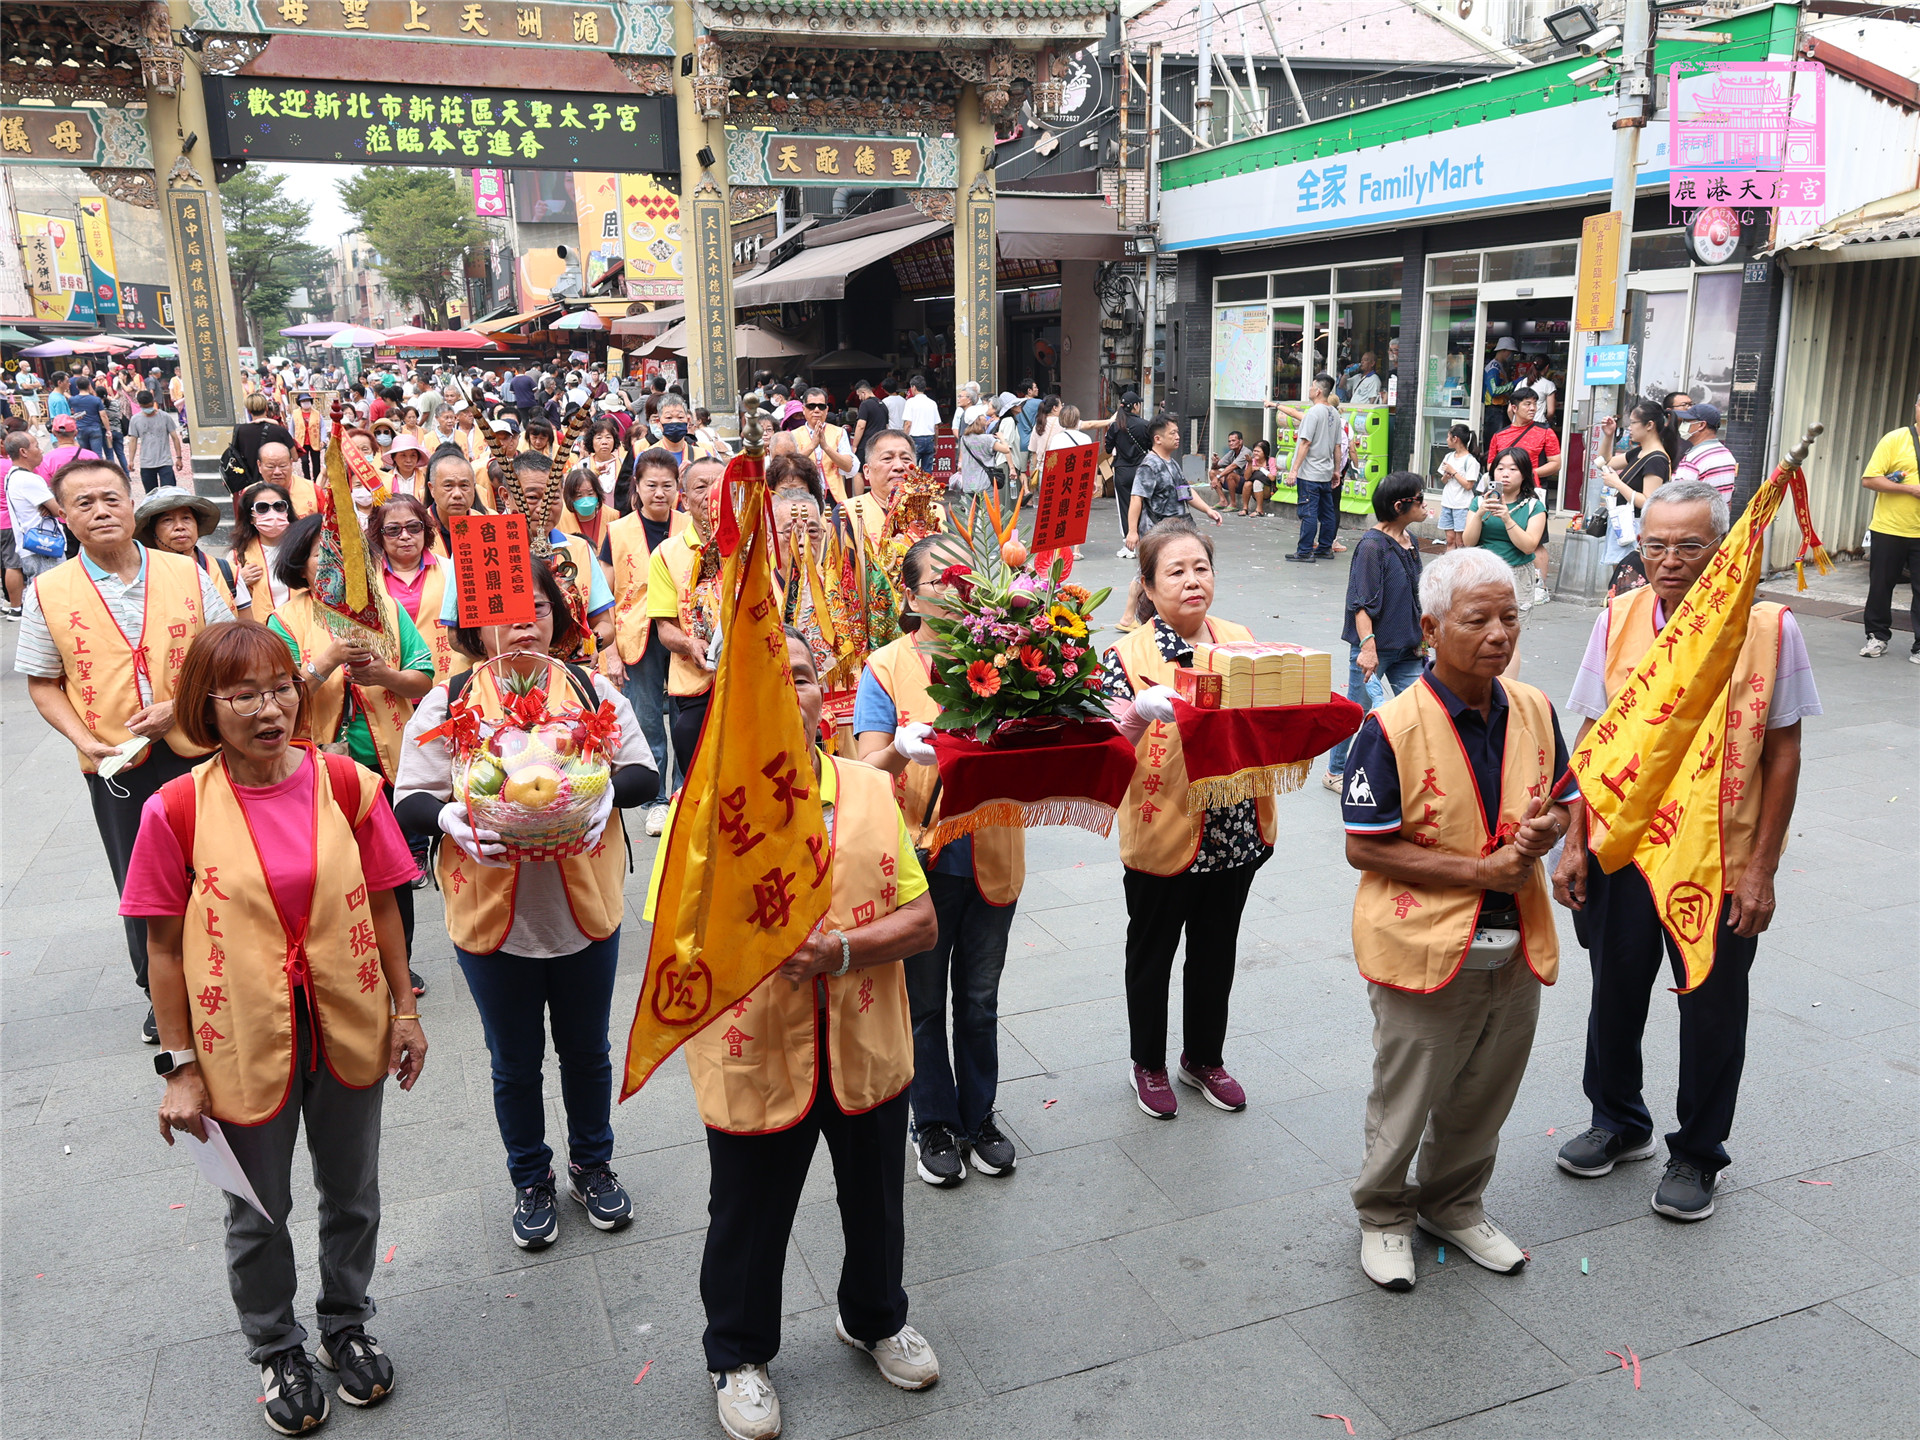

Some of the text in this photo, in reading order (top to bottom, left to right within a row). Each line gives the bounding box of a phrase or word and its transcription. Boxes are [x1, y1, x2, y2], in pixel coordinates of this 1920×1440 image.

[246, 87, 641, 133] 歡迎新北市新莊區天聖太子宮
[364, 124, 545, 159] 蒞臨本宮進香
[1296, 153, 1484, 213] 全家 FamilyMart
[1752, 270, 1763, 281] 92
[1054, 453, 1077, 540] 香火鼎盛
[480, 522, 504, 615] 香火鼎盛
[505, 520, 526, 594] 恭祝 鹿港天后宮
[68, 610, 102, 731] 天上聖母會
[1748, 672, 1767, 744] 台中市
[196, 866, 230, 1055] 天上聖母會
[345, 882, 381, 995] 四張犁
